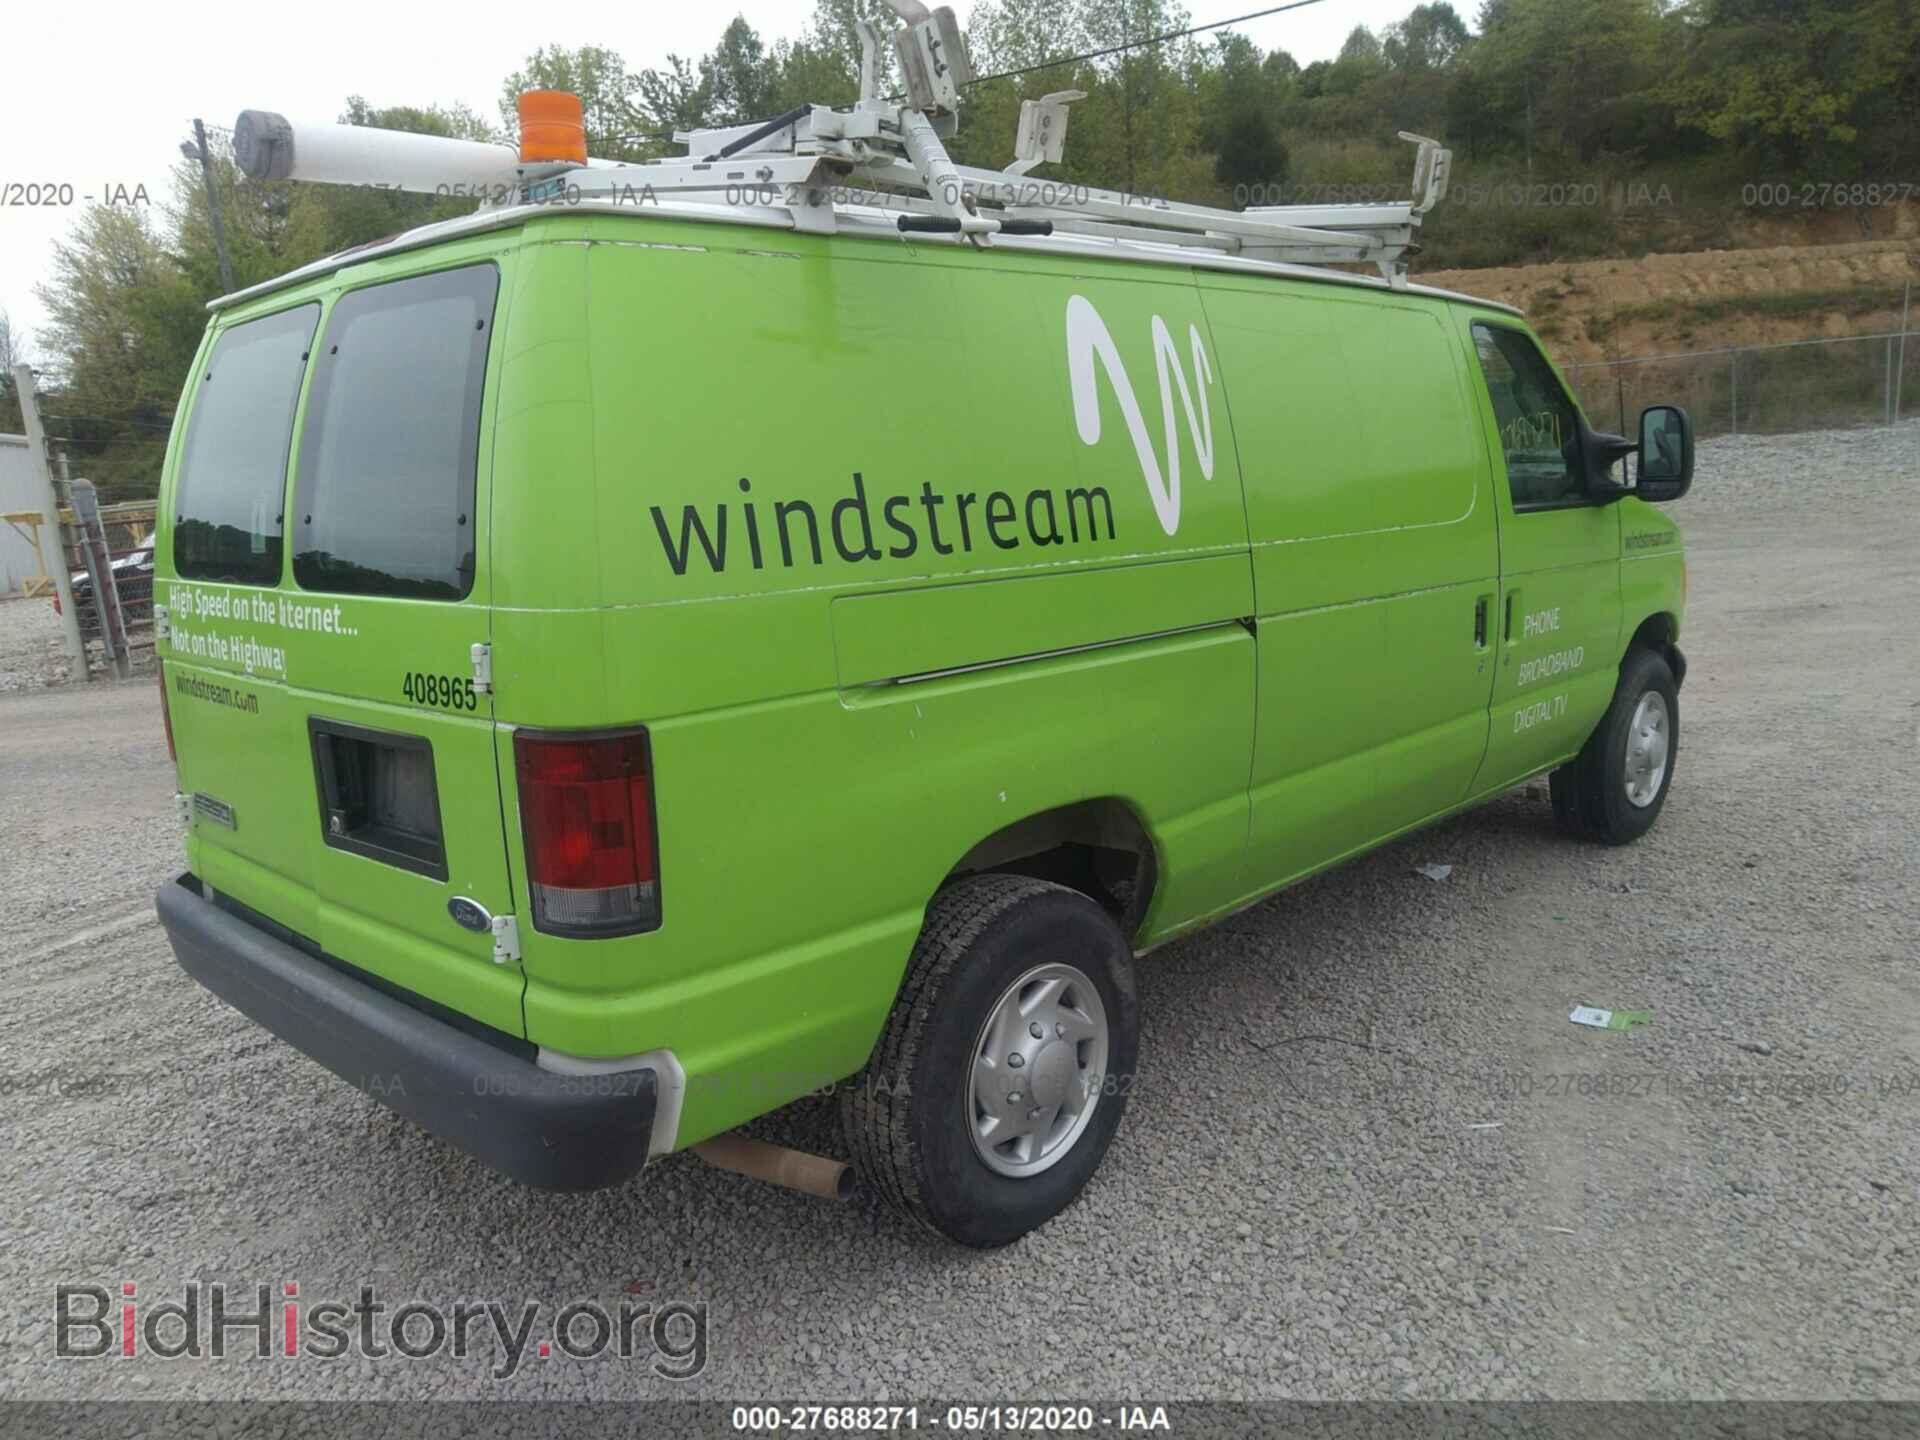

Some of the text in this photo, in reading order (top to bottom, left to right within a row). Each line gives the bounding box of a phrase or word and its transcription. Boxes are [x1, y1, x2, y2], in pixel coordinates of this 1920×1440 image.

[649, 471, 1117, 576] windstream
[169, 585, 193, 619] High
[195, 588, 230, 623] Speed
[233, 597, 249, 620] on
[252, 591, 275, 624] the
[1523, 607, 1560, 639] PHONE
[171, 624, 190, 653] Not
[192, 634, 207, 656] on
[208, 629, 228, 660] the
[1518, 646, 1584, 686] BROADBAND
[176, 670, 259, 714] windstream.com
[402, 671, 477, 711] 408965
[1513, 694, 1569, 733] DIGITAL TV
